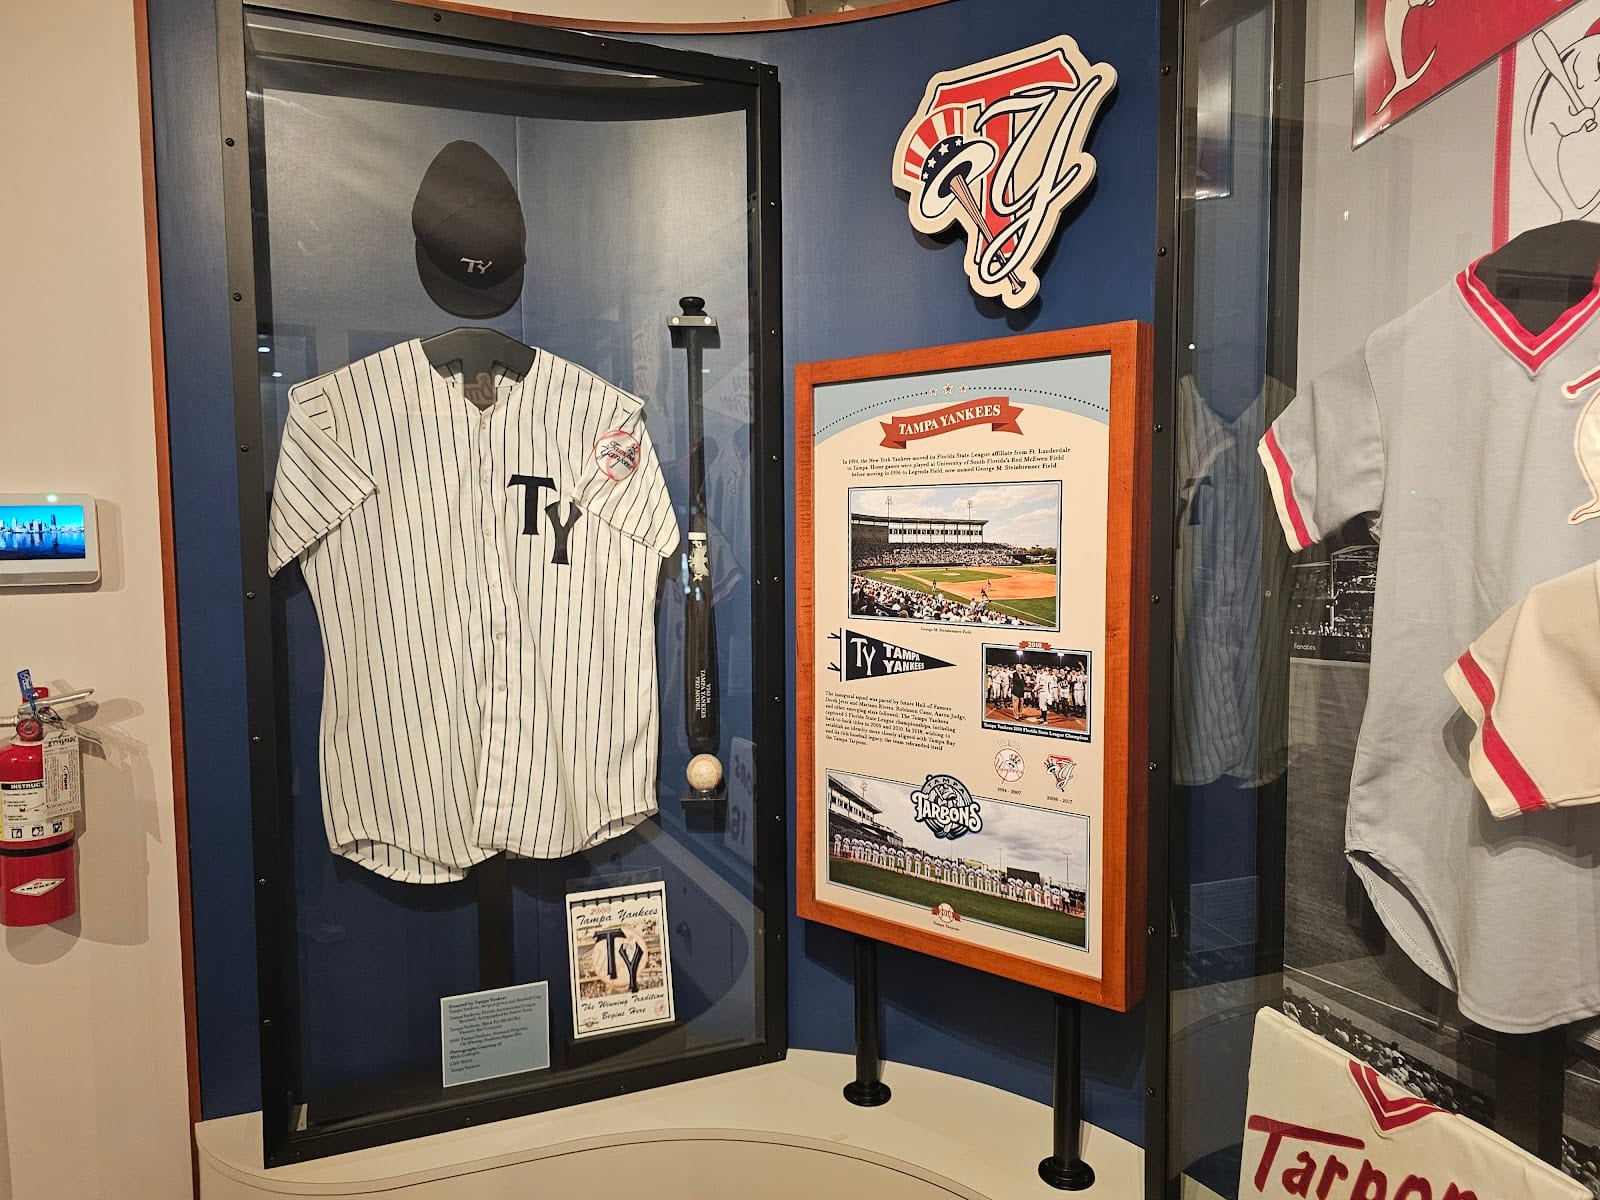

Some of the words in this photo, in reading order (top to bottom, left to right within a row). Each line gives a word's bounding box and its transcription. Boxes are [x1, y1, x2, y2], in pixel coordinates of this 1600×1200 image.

[460, 257, 492, 275] TY
[898, 419, 940, 435] TAMPA
[940, 404, 1000, 427] YANKEES
[507, 474, 583, 565] TY
[882, 643, 920, 661] TAMPA
[1294, 642, 1316, 651] Fanatics
[850, 638, 876, 676] TY
[882, 660, 924, 673] YANKEES
[846, 706, 866, 714] emerging
[877, 717, 894, 725] League
[932, 724, 955, 733] including
[833, 735, 847, 743] Tampa
[905, 740, 929, 748] rebranded
[927, 778, 964, 793] TAMPA
[912, 790, 982, 832] TARPONS
[576, 914, 612, 925] Tampa
[618, 907, 658, 921] Yankees
[592, 928, 644, 993] TY
[598, 1000, 628, 1008] Winning
[632, 993, 664, 1002] Tradition
[602, 1011, 624, 1020] Begins
